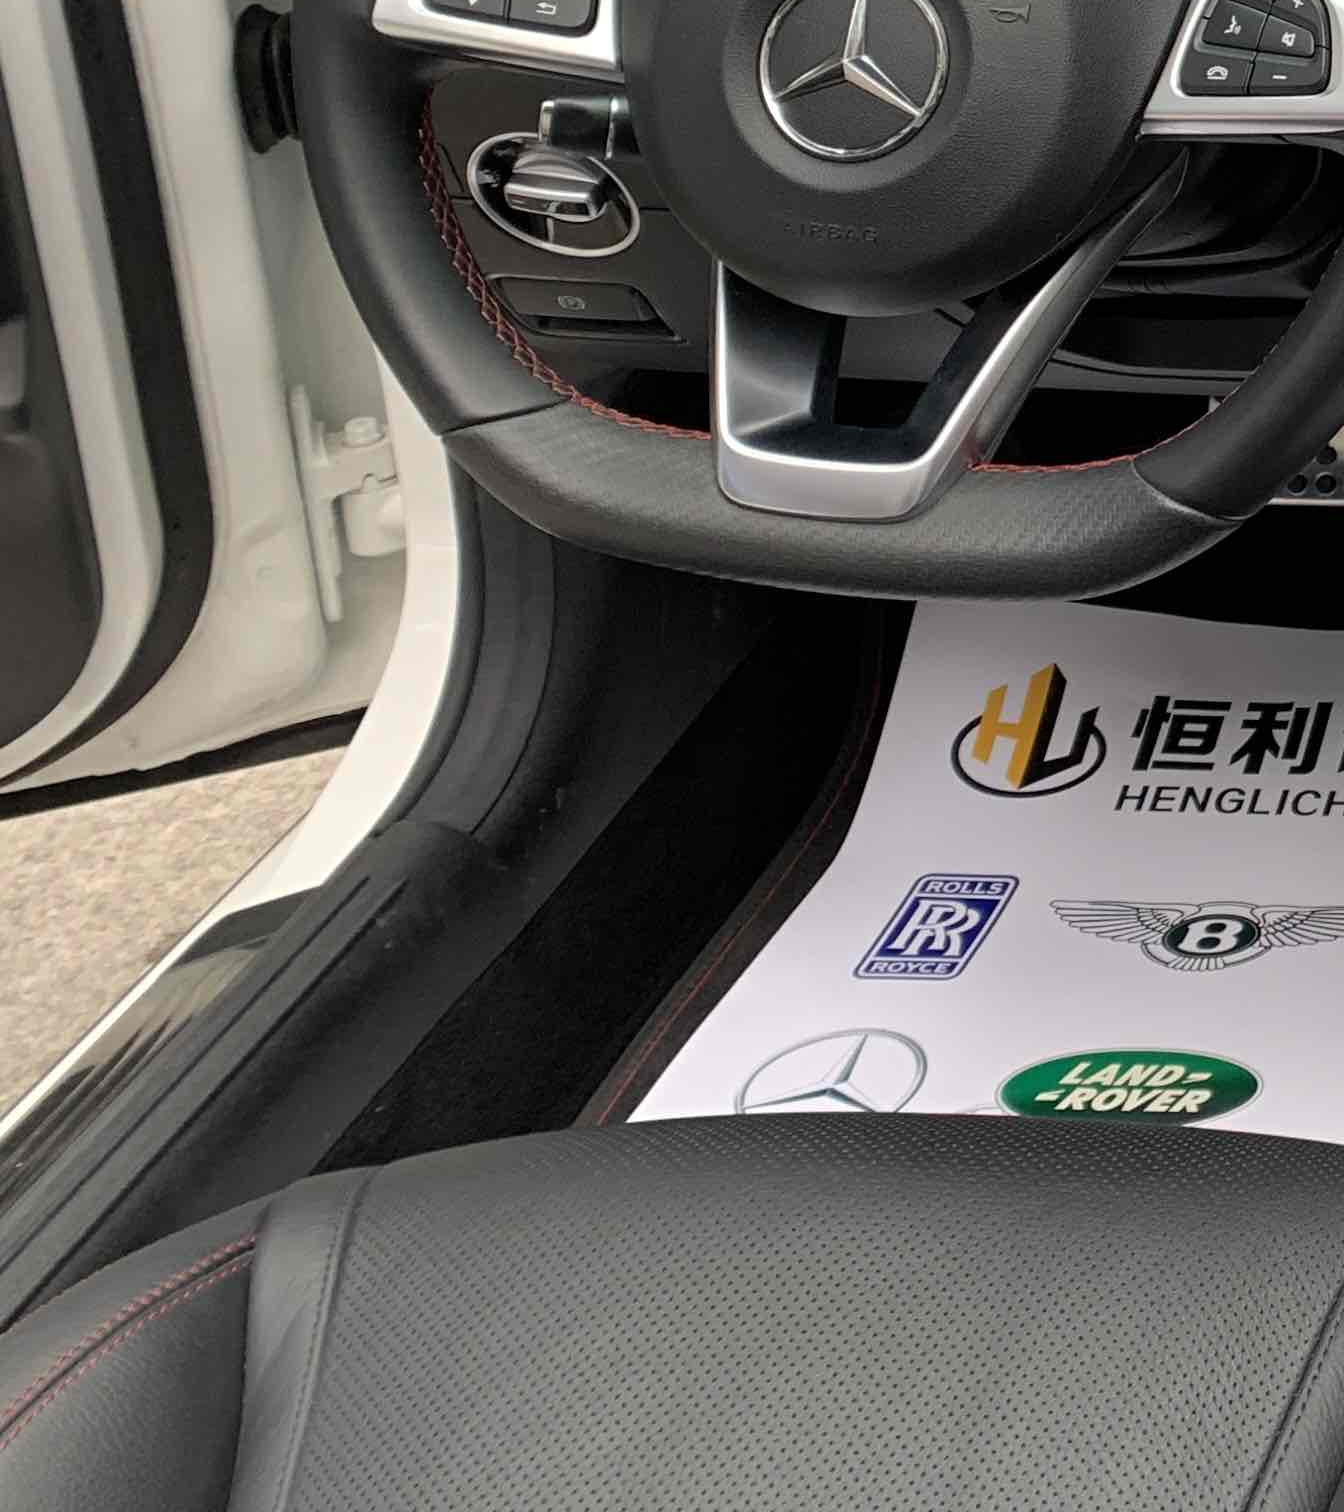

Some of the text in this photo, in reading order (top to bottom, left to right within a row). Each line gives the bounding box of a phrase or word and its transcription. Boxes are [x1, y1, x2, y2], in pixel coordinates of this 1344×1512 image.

[925, 880, 1004, 895] ROLLS
[869, 962, 951, 974] ROYCE
[1054, 1088, 1213, 1113] ROVER
